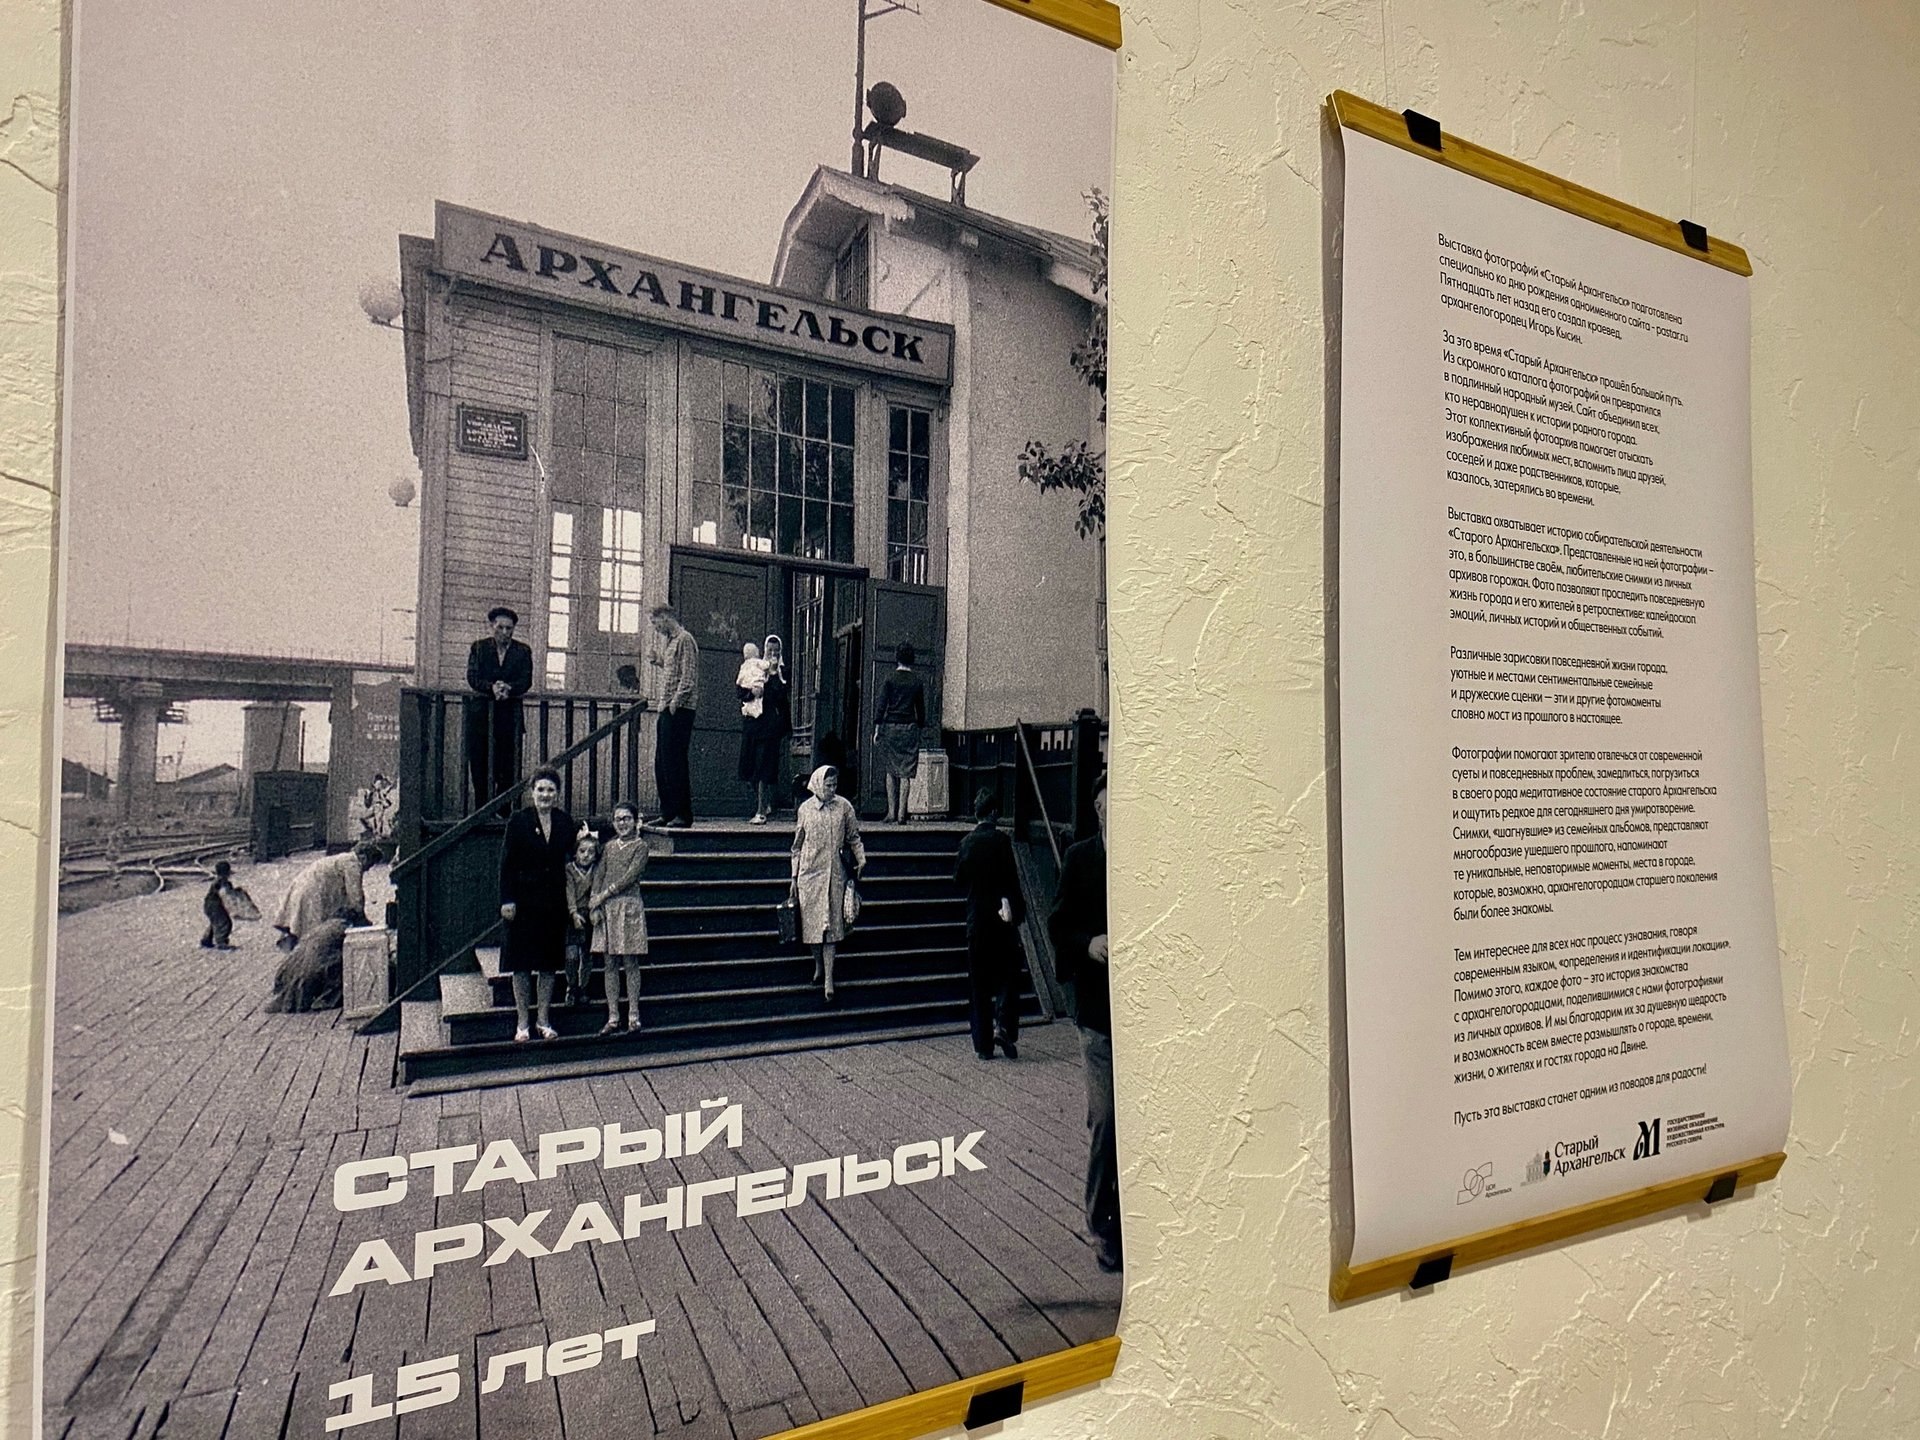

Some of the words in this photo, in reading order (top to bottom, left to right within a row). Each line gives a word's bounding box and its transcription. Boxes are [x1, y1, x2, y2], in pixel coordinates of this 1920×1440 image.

[1438, 233, 1482, 258] Выставка
[1484, 249, 1538, 277] фотографий
[1540, 269, 1576, 289] «Старый
[1631, 301, 1682, 324] подготовлена
[1439, 255, 1494, 281] специально
[1508, 278, 1526, 291] дню
[1527, 284, 1569, 304] рождения
[480, 232, 923, 363] АРХАНГЕЛЬСК
[1440, 271, 1495, 299] Пятнадцать
[1496, 292, 1511, 304] лет
[1513, 298, 1540, 315] назад
[1541, 306, 1556, 318] его
[1557, 311, 1586, 328] создал
[1441, 294, 1527, 329] архангелогородец
[1528, 317, 1554, 336] Игорь
[1555, 325, 1582, 344] Кысин.
[1442, 329, 1455, 344] За
[1456, 336, 1472, 349] это
[1473, 341, 1502, 357] время
[1503, 348, 1542, 368] «Старый
[1543, 359, 1598, 382] Архангельск»
[1443, 348, 1455, 363] Из
[1456, 356, 1506, 377] скромного
[1507, 370, 1547, 388] каталога
[1548, 378, 1599, 401] фотографий
[1451, 373, 1501, 394] подлинный
[1503, 387, 1547, 406] народный
[1548, 399, 1575, 413] музей.
[1444, 391, 1460, 403] кто
[1462, 396, 1528, 419] неравнодушен
[1536, 414, 1571, 430] истории
[1445, 407, 1467, 424] Этот
[1469, 417, 1531, 438] коллективный
[1532, 428, 1578, 449] фотоархив
[1445, 430, 1508, 452] изображения
[1510, 444, 1550, 461] любимых
[1551, 454, 1573, 467] мест,
[1446, 450, 1485, 466] соседей
[1494, 460, 1518, 473] даже
[1519, 465, 1584, 486] родственников,
[1447, 470, 1492, 488] казалось,
[1493, 479, 1544, 496] затерялись
[1557, 491, 1594, 506] времени.
[1447, 506, 1492, 525] Выставка
[1493, 517, 1545, 533] охватывает
[1547, 526, 1583, 541] историю
[1650, 543, 1702, 557] деятельности
[1448, 527, 1493, 545] «Старого
[1448, 549, 1466, 562] это,
[1475, 549, 1534, 569] большинстве
[1535, 561, 1564, 574] своём,
[1449, 569, 1488, 583] архивов
[1489, 574, 1530, 588] горожан.
[1531, 577, 1555, 591] Фото
[1556, 583, 1600, 596] позволяют
[1649, 594, 1705, 610] повседневную
[1449, 589, 1477, 601] жизнь
[1479, 592, 1512, 606] города
[1521, 597, 1537, 608] его
[1538, 599, 1575, 611] жителей
[1450, 609, 1487, 622] эмоций,
[1489, 613, 1522, 625] личных
[1523, 617, 1559, 630] историй
[1450, 645, 1501, 661] Различные
[1503, 653, 1550, 666] зарисовки
[1551, 656, 1610, 669] повседневной
[1450, 669, 1486, 682] уютные
[1495, 672, 1536, 683] местами
[1537, 674, 1612, 687] сентиментальные
[1459, 689, 1509, 703] дружеские
[1511, 692, 1542, 703] сценки
[1553, 694, 1568, 703] эти
[1451, 709, 1485, 719] словно
[1487, 710, 1510, 720] мост
[1523, 711, 1568, 724] прошлого
[1452, 746, 1512, 762] Фотографии
[1513, 750, 1557, 760] помогают
[1559, 750, 1596, 763] зрителю
[1649, 750, 1702, 763] современной
[1451, 769, 1479, 782] суеты
[1489, 769, 1553, 780] повседневных
[1555, 766, 1595, 781] проблем,
[1459, 789, 1492, 799] своего
[1494, 788, 1518, 802] рода
[1519, 788, 1582, 799] медитативное
[1460, 808, 1500, 822] ощутить
[1502, 808, 1535, 821] редкое
[1536, 807, 1552, 818] для
[1553, 806, 1613, 817] сегодняшнего
[1452, 826, 1491, 839] Снимки,
[1493, 826, 1553, 840] «шагнувшие»
[1653, 821, 1708, 834] представляют
[1453, 844, 1522, 860] многообразие
[1524, 845, 1569, 859] ушедшего
[1453, 870, 1464, 880] те
[1466, 866, 1523, 882] уникальные,
[1524, 862, 1590, 876] неповторимые
[1453, 888, 1496, 902] которые,
[1497, 884, 1545, 897] возможно,
[1676, 872, 1717, 883] поколения
[1453, 906, 1478, 921] были
[1480, 904, 1509, 918] более
[1511, 903, 1553, 915] знакомы.
[1453, 948, 1472, 961] Тем
[1473, 944, 1529, 960] интереснее
[1531, 942, 1548, 954] для
[1549, 940, 1569, 951] всех
[1570, 937, 1586, 948] нас
[1453, 965, 1520, 983] современным
[1522, 961, 1557, 973] языком,
[1454, 988, 1493, 1002] Помимо
[1495, 984, 1523, 996] этого,
[1524, 979, 1558, 992] каждое
[1560, 975, 1582, 990] фото
[1642, 962, 1688, 976] знакомства
[1461, 998, 1564, 1023] архангелогородцами,
[1664, 976, 1723, 994] фотографиями
[1454, 1032, 1465, 1043] из
[1467, 1026, 1501, 1041] личных
[1503, 1020, 1543, 1037] архивов.
[1462, 1043, 1524, 1062] возможность
[1526, 1039, 1549, 1050] всем
[1550, 1032, 1582, 1046] вместе
[1454, 1070, 1486, 1083] жизни,
[1496, 1060, 1534, 1075] жителях
[1543, 1053, 1573, 1067] гостях
[1574, 1047, 1606, 1063] города
[1454, 1111, 1482, 1127] Пусть
[1483, 1106, 1500, 1119] эта
[1502, 1097, 1545, 1115] выставка
[1547, 1091, 1577, 1105] станет
[1671, 1063, 1706, 1083] радости!
[333, 1096, 743, 1212] СТАРЫЙ
[1554, 1135, 1599, 1158] Старый
[1553, 1147, 1627, 1177] Архангельск
[329, 1130, 986, 1297] АРХАНГЕЛЬСК
[325, 1354, 460, 1432] 15
[481, 1319, 656, 1394] лет
